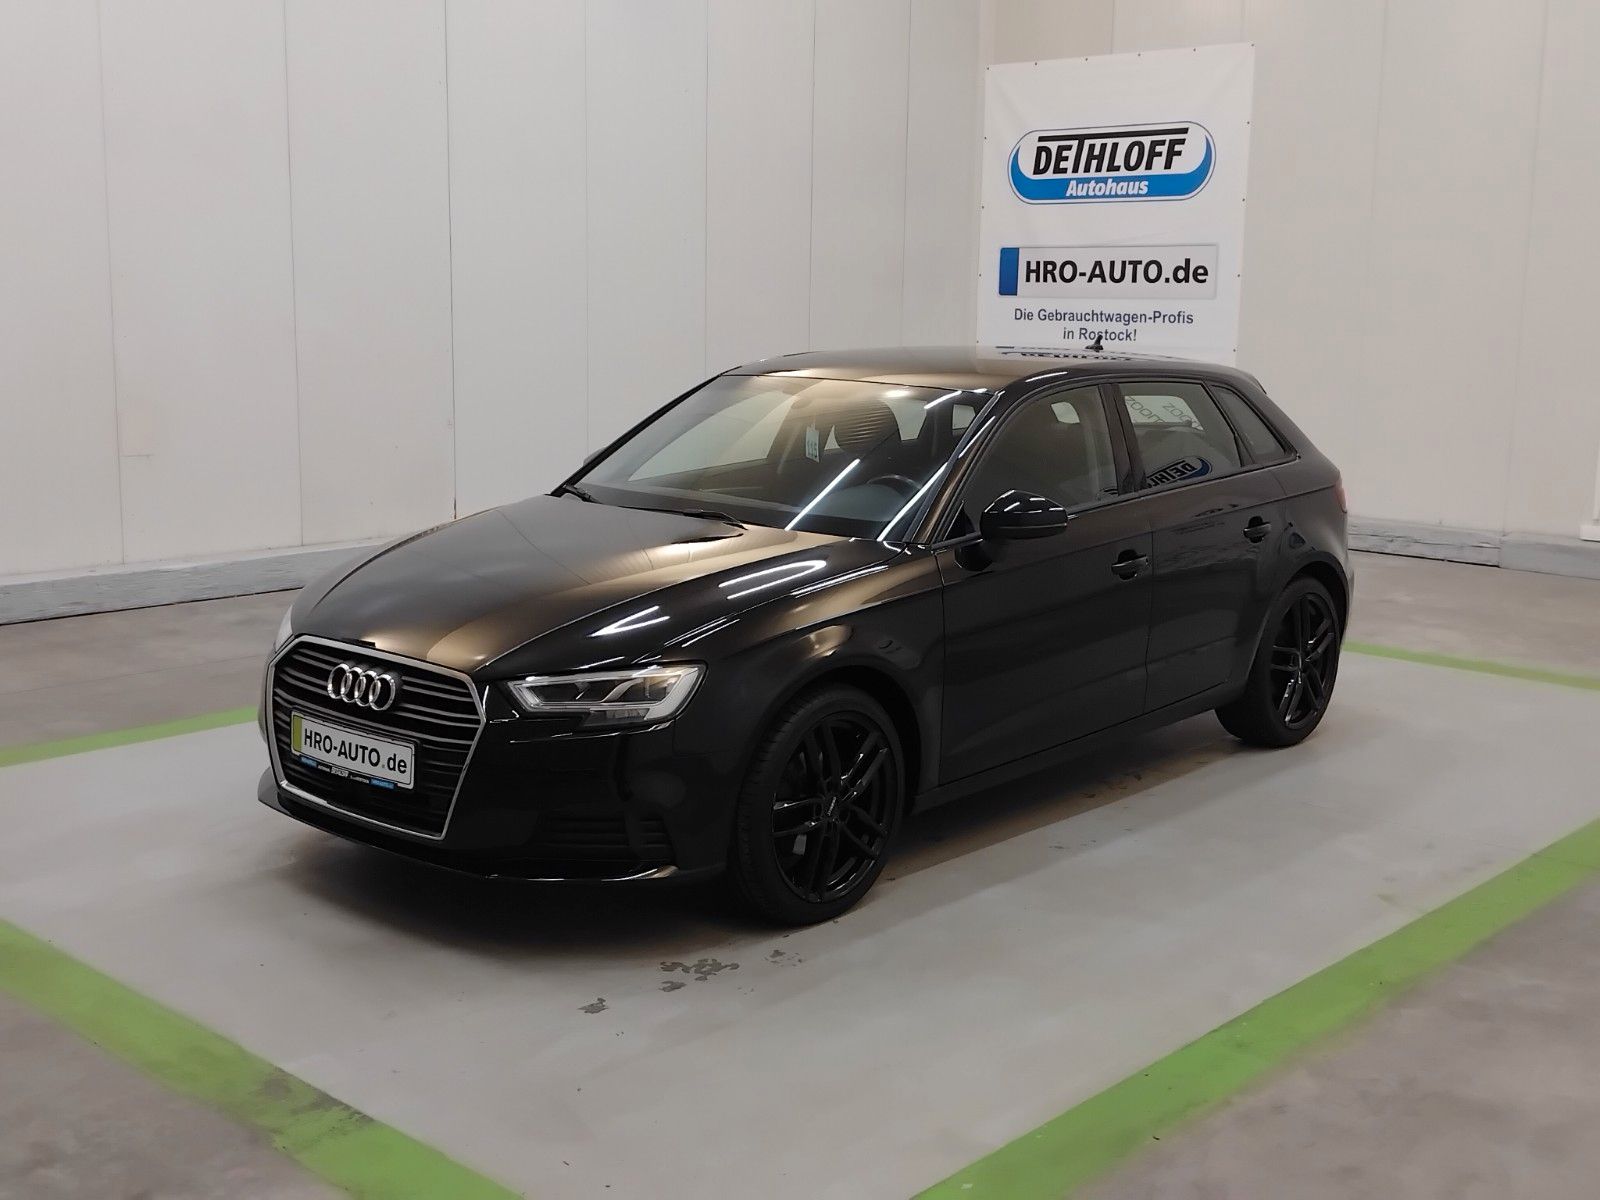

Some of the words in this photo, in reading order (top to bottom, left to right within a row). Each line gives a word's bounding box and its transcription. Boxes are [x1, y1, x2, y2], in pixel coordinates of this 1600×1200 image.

[1033, 127, 1189, 175] DETHLOFF
[1066, 178, 1149, 197] Autohaus
[1024, 257, 1209, 284] HRO-AUTO.de
[1014, 308, 1034, 321] Die
[1037, 309, 1194, 325] Gebrauchtwagen-Profis
[1063, 327, 1075, 340] in
[304, 728, 408, 774] HRO-AUTO.de
